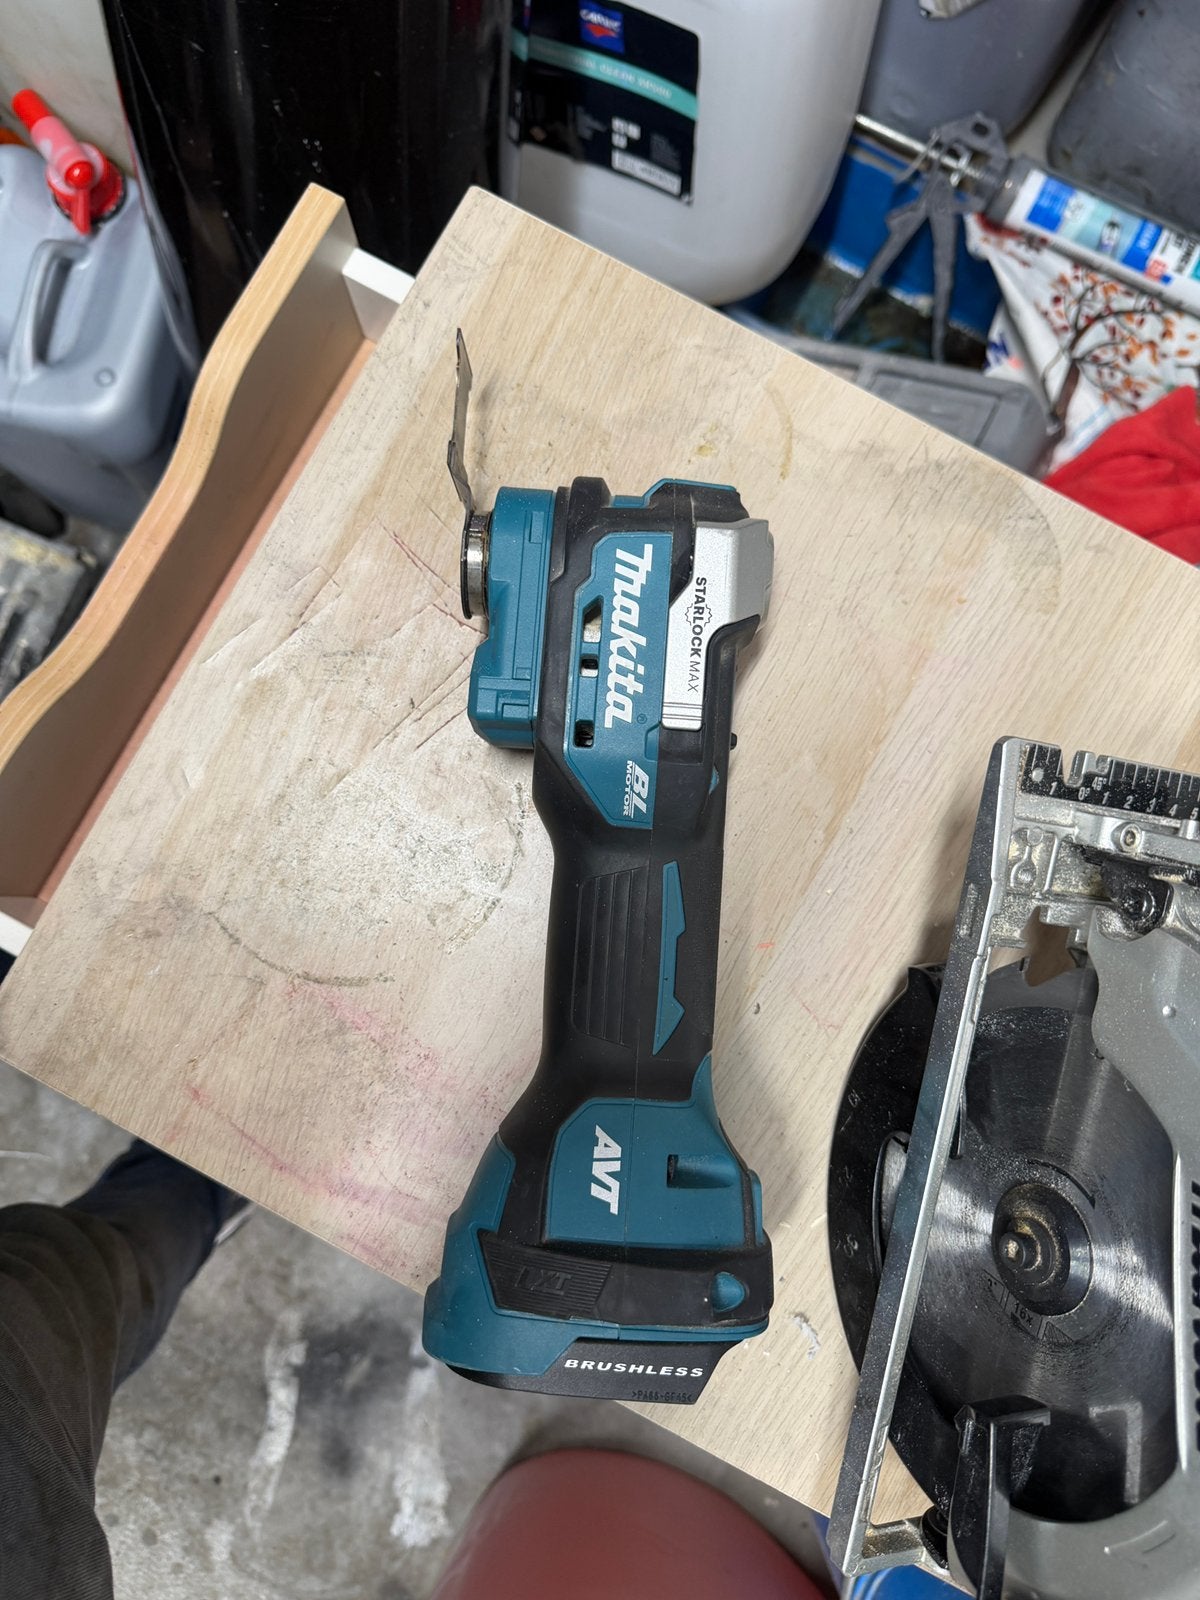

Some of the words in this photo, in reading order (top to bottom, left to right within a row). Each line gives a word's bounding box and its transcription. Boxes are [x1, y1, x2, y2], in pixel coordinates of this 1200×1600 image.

[604, 543, 654, 729] Makita
[690, 576, 707, 658] STARLOCK
[687, 660, 701, 693] MAX
[623, 760, 633, 817] MOTOR
[632, 761, 650, 819] BL
[1123, 795, 1134, 809] 2
[1168, 804, 1179, 817] 4
[1189, 807, 1199, 820] 5
[590, 1124, 623, 1216] AVT
[563, 1358, 704, 1378] BRUSHLESS
